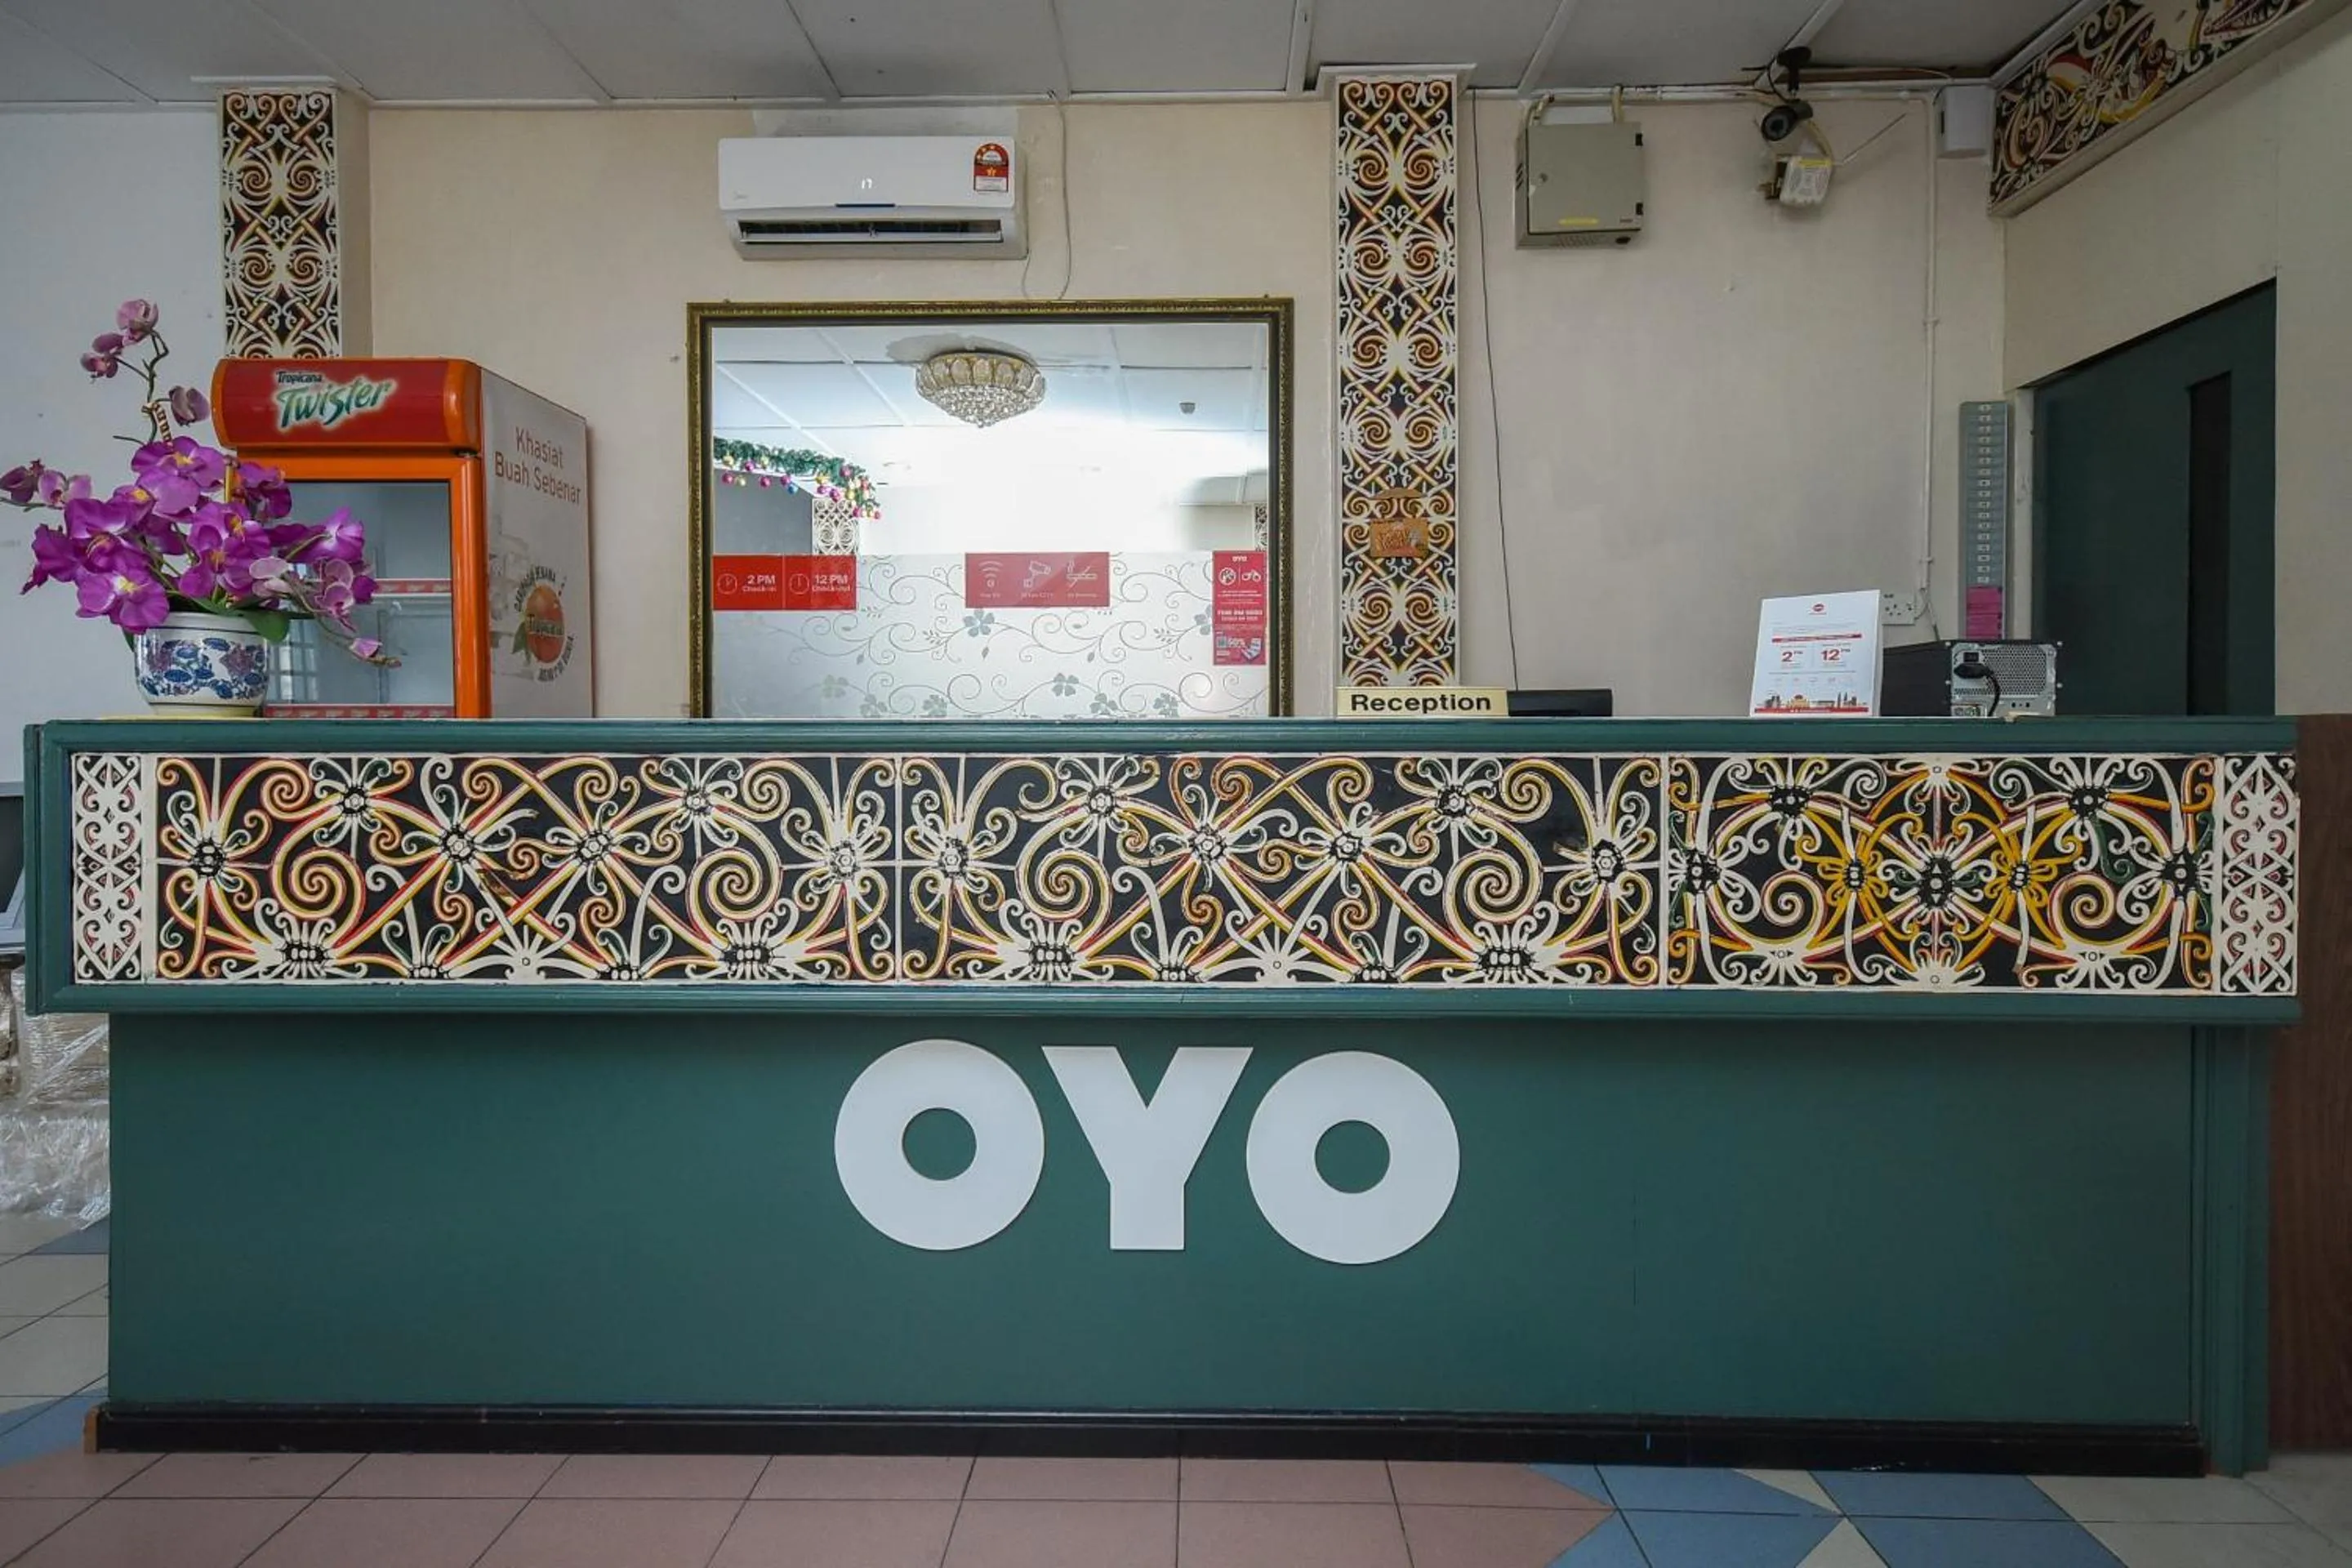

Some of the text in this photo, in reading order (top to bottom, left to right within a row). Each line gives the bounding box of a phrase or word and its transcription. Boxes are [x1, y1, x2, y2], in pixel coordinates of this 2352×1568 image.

[275, 371, 323, 385] Tropicana
[276, 377, 393, 428] Twister
[514, 425, 564, 470] Khasiat
[494, 450, 581, 505] Buah Sebenar
[747, 574, 777, 586] 2 PM
[814, 574, 849, 586] 12 PM
[1781, 651, 1793, 663] 2
[1820, 648, 1841, 662] 12
[1350, 693, 1492, 715] Reception
[834, 1039, 1461, 1265] OYO
